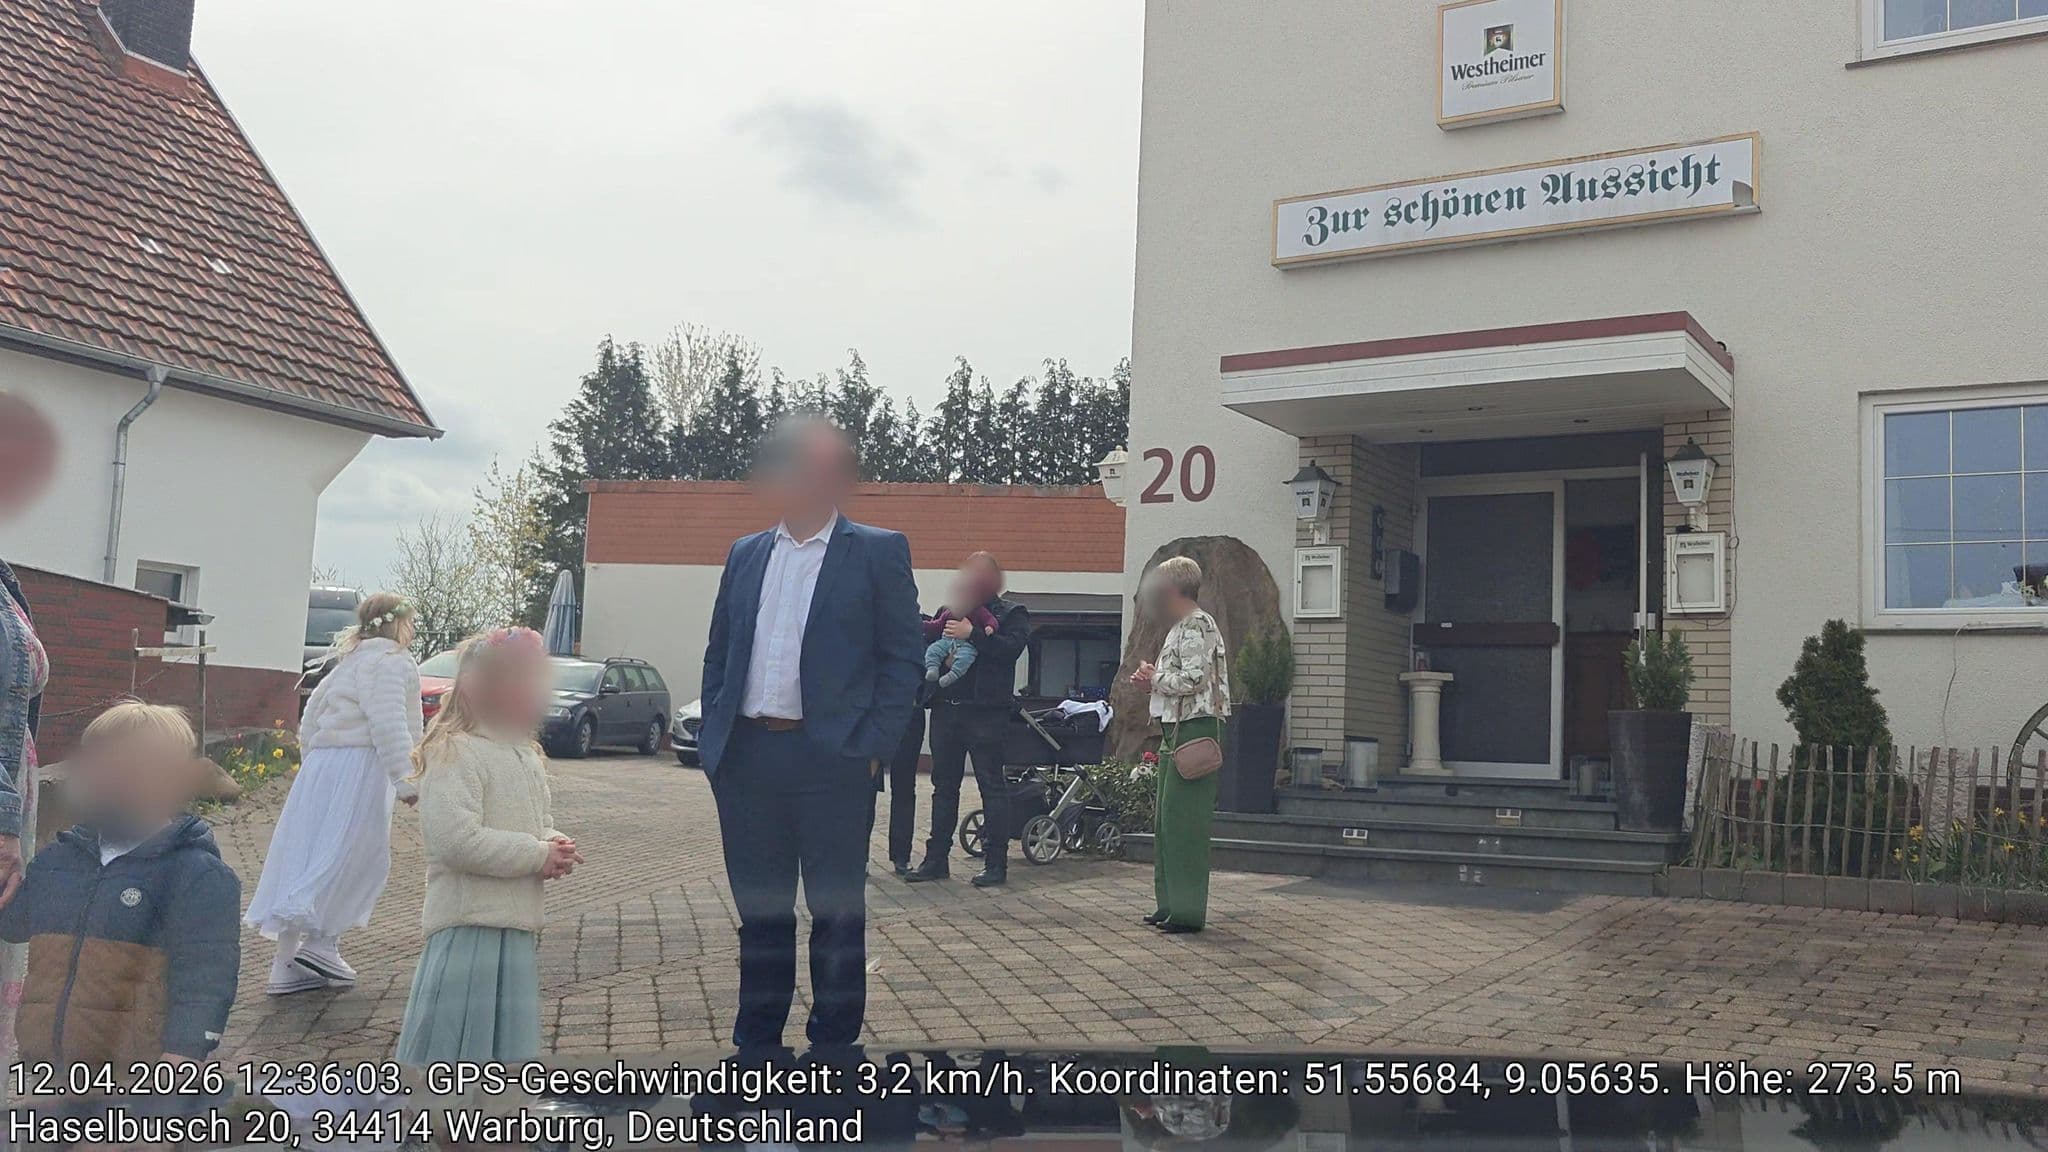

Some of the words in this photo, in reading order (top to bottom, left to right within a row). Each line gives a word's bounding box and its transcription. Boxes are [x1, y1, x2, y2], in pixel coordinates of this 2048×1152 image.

[1450, 52, 1546, 80] Westheimer
[1301, 206, 1370, 247] Zur
[1383, 187, 1527, 232] schönen
[1540, 153, 1721, 205] Aussicht
[1140, 445, 1216, 504] 20
